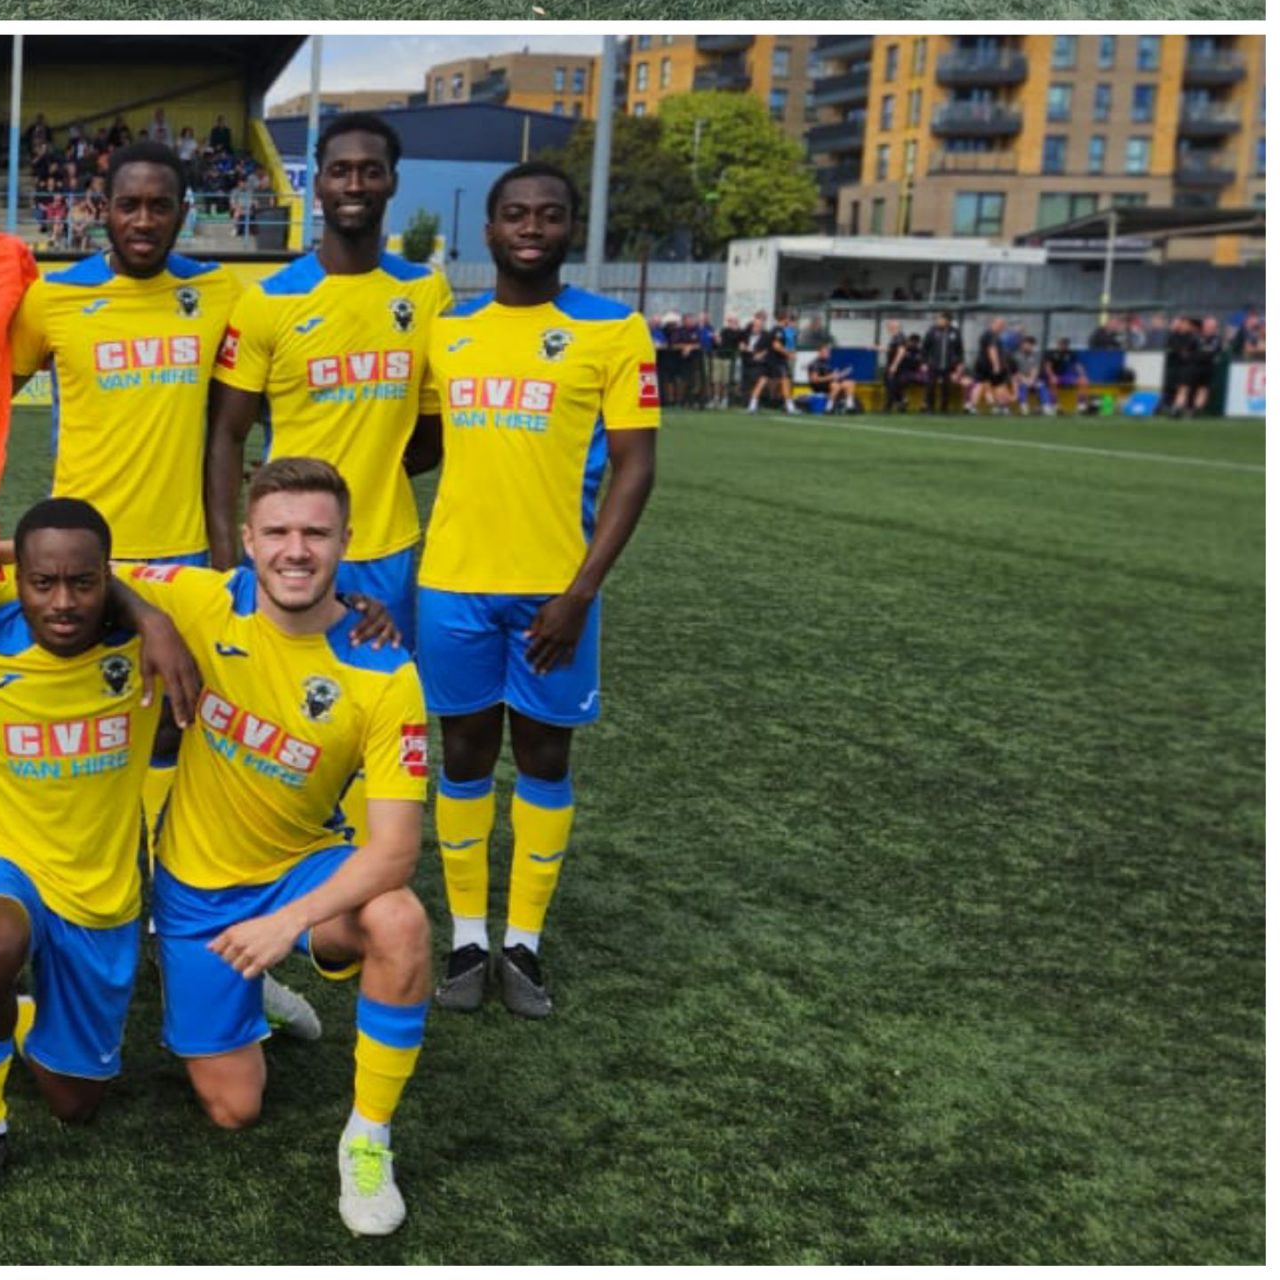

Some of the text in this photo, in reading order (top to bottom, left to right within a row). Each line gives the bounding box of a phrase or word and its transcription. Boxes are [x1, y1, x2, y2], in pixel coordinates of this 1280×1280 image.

[95, 336, 200, 372] CVS
[308, 350, 413, 387] CVS
[97, 367, 199, 391] VAN HIRE
[311, 381, 409, 403] VAN HIRE
[449, 378, 555, 412] CVS
[493, 412, 548, 433] HIRE
[4, 712, 130, 757] CVS
[198, 690, 322, 774] CVS
[7, 749, 129, 780] VAN HIRE
[242, 753, 308, 790] HIRE
